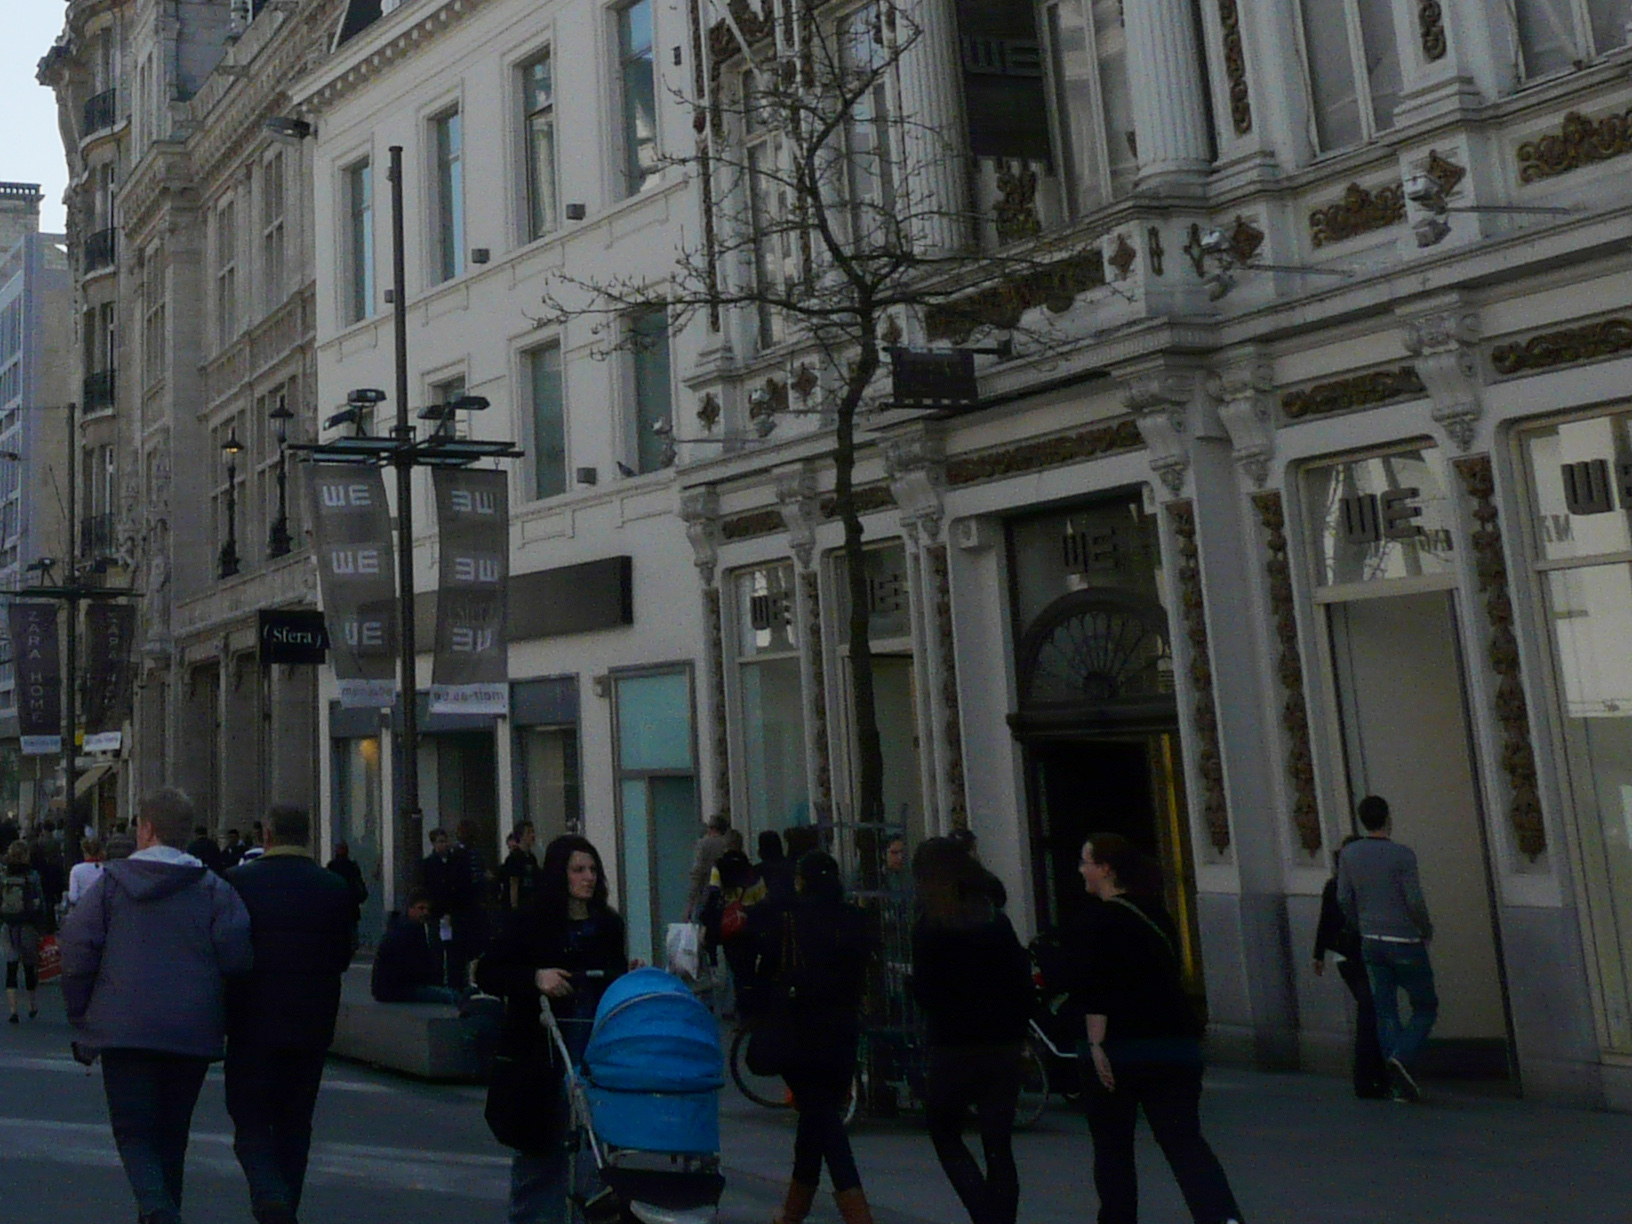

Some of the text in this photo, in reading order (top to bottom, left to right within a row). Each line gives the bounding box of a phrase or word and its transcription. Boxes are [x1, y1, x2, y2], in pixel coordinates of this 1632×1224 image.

[321, 484, 371, 507] WE
[1341, 487, 1422, 544] WE
[332, 550, 379, 574] WE
[28, 611, 41, 659] ZARA
[31, 672, 44, 723] HOME
